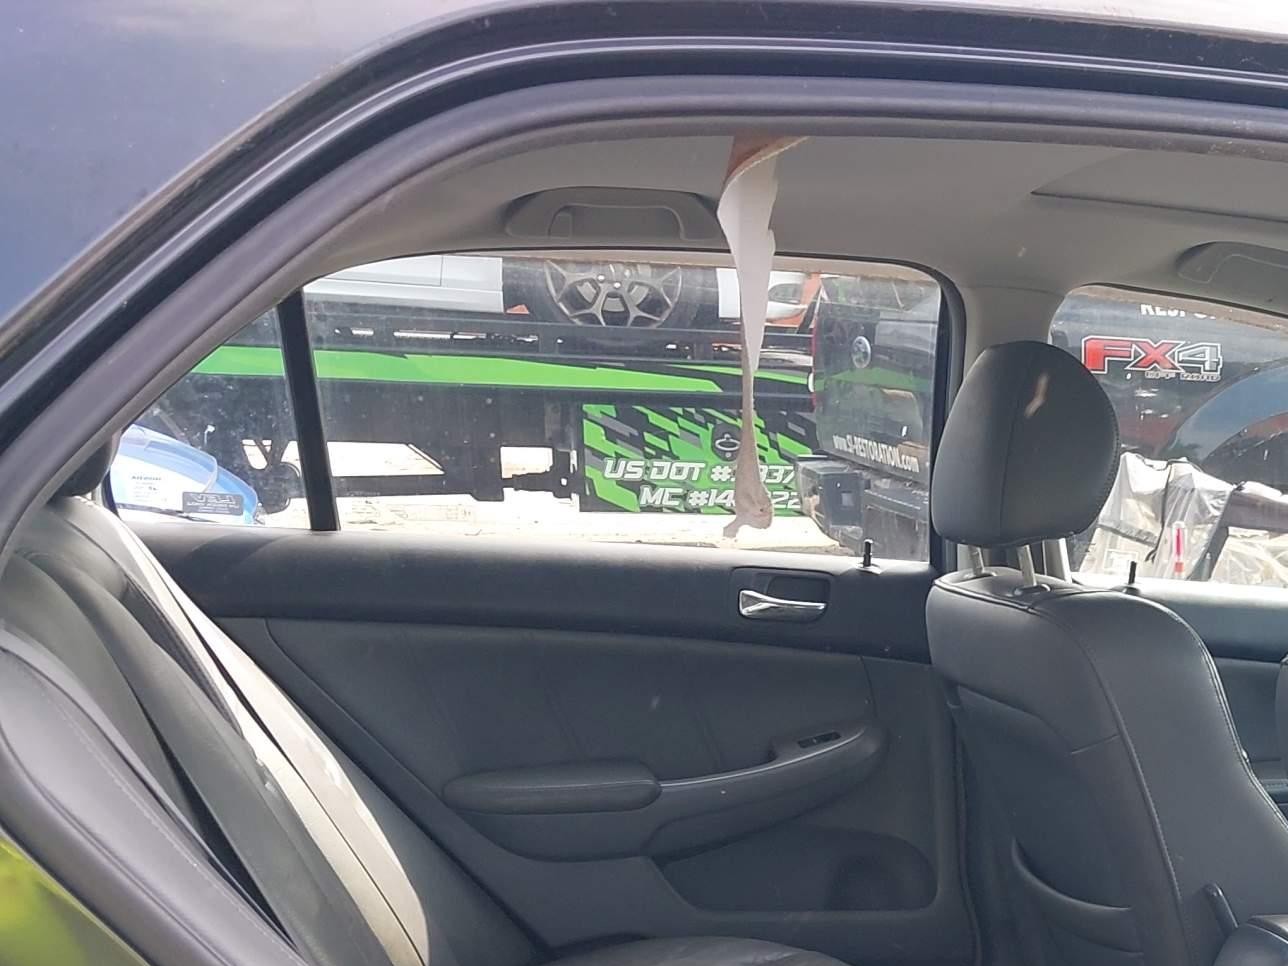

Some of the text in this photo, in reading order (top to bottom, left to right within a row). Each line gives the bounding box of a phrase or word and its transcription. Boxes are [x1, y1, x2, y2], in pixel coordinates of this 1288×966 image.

[1081, 335, 1223, 375] FX4
[603, 459, 645, 479] US
[650, 462, 705, 481] DOT
[639, 486, 682, 505] MC
